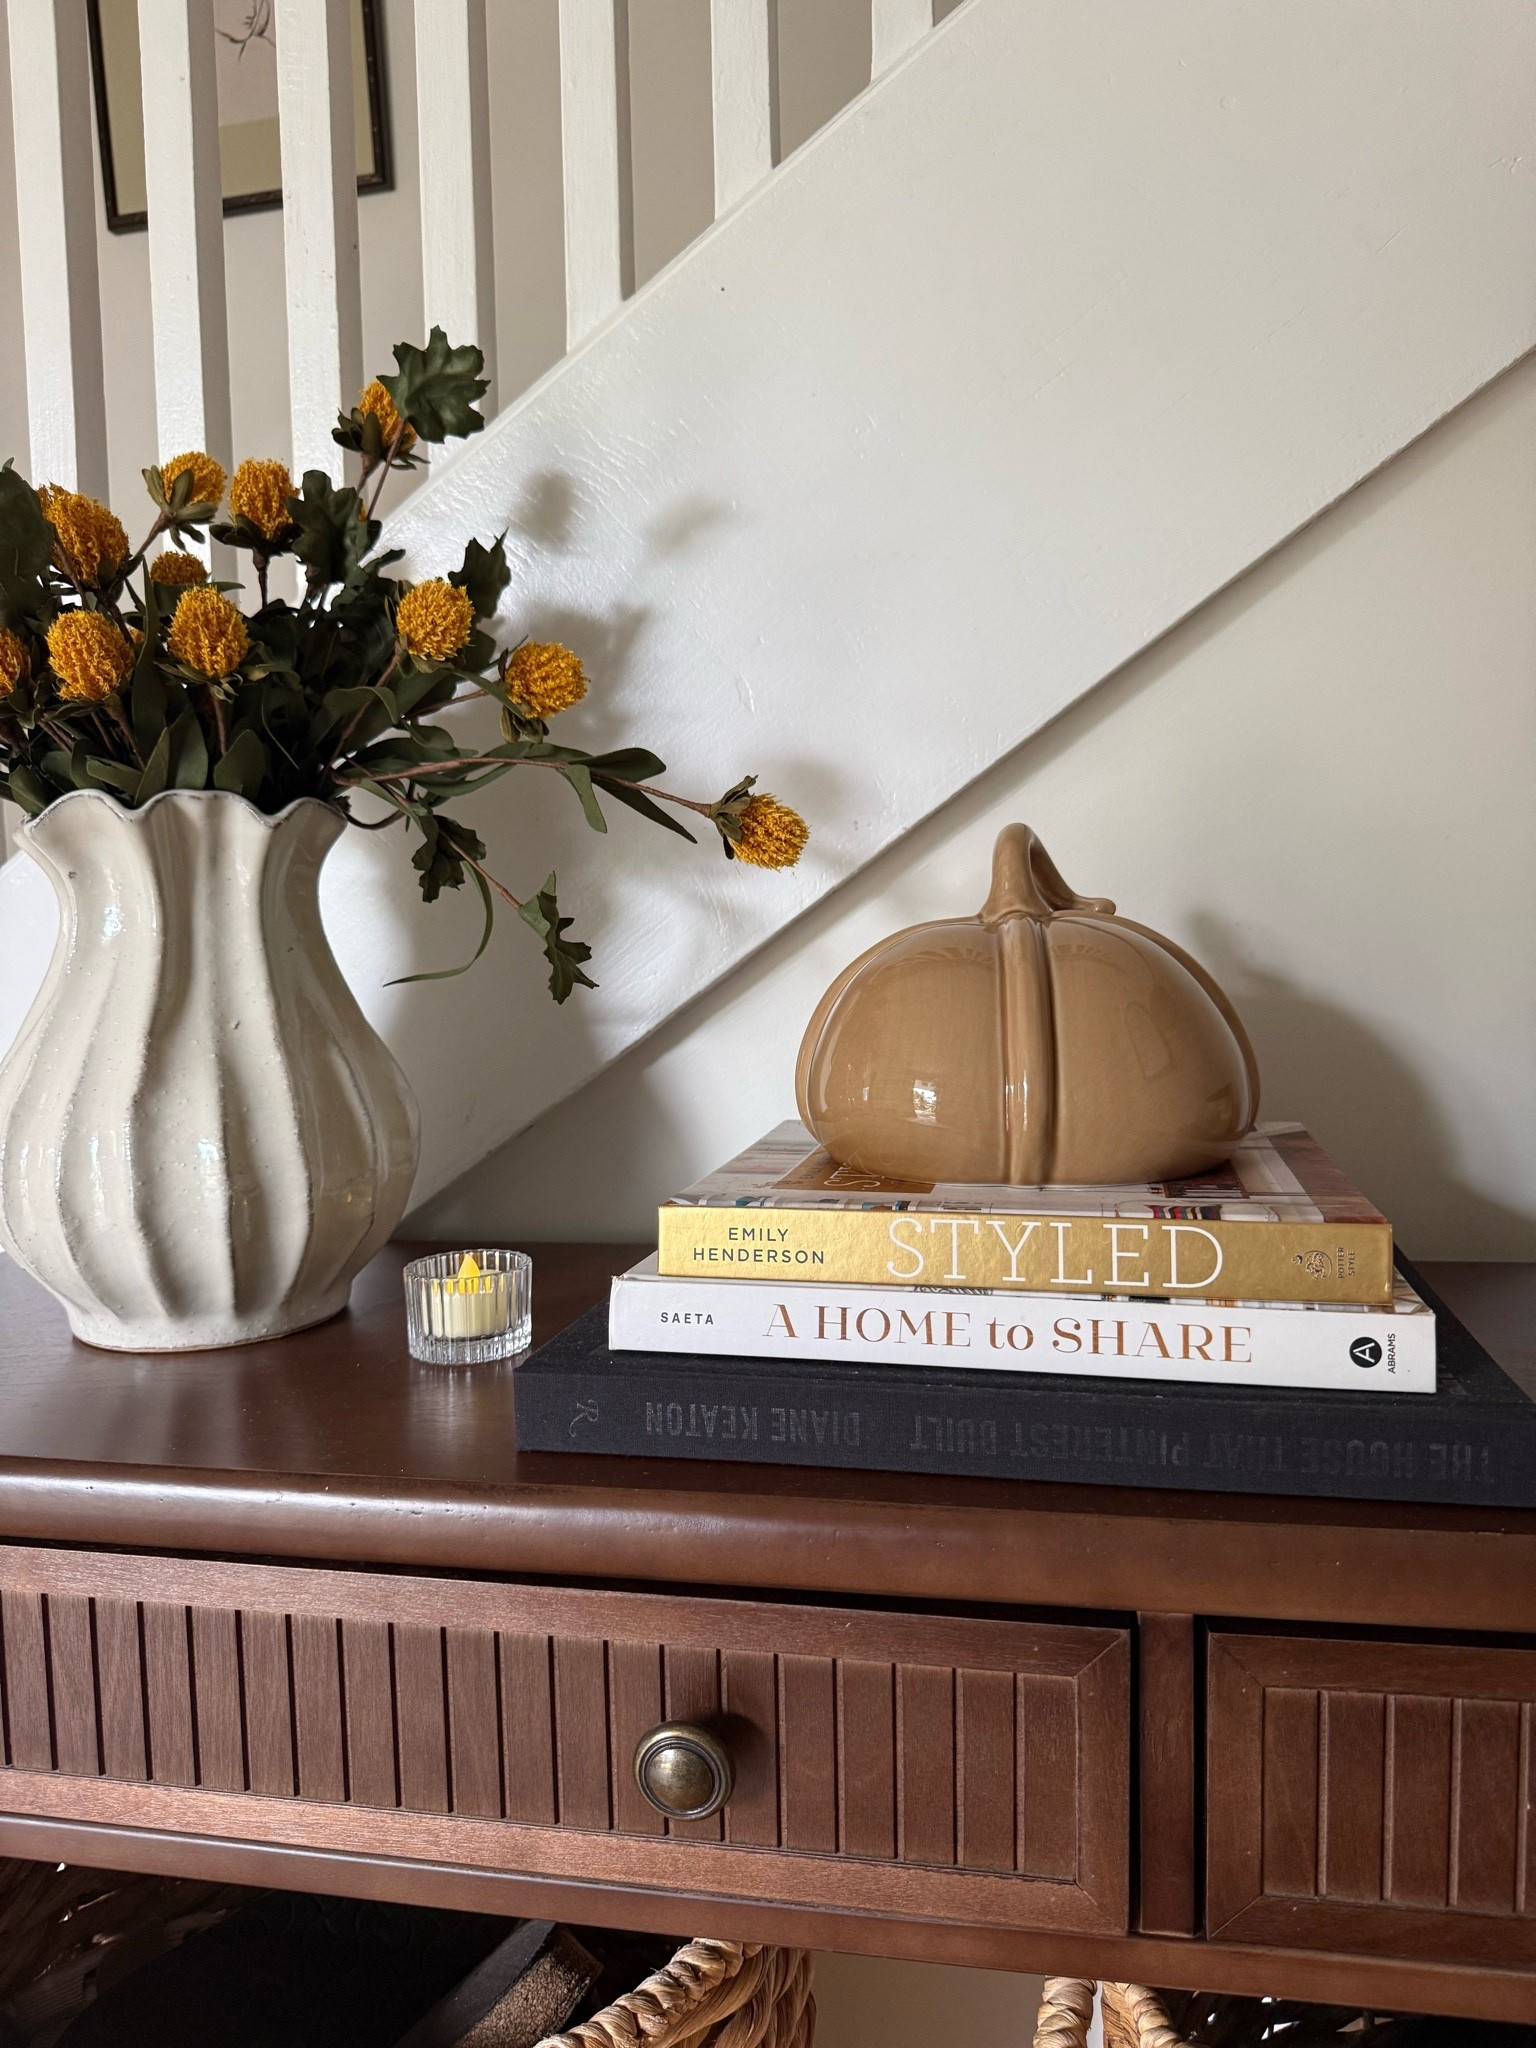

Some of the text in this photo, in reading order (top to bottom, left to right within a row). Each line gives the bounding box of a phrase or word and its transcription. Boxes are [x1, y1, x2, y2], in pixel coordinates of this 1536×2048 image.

[728, 1227, 789, 1242] EMILY
[693, 1247, 825, 1265] HENDERSON
[886, 1217, 1223, 1289] STYLED
[1337, 1247, 1345, 1279] POTTER
[1347, 1250, 1356, 1276] STYLE
[660, 1311, 714, 1326] SAETA
[762, 1303, 1252, 1363] A HOME to SHARE
[1387, 1333, 1396, 1374] ABRAMS
[645, 1401, 861, 1447] DIANE KEATON
